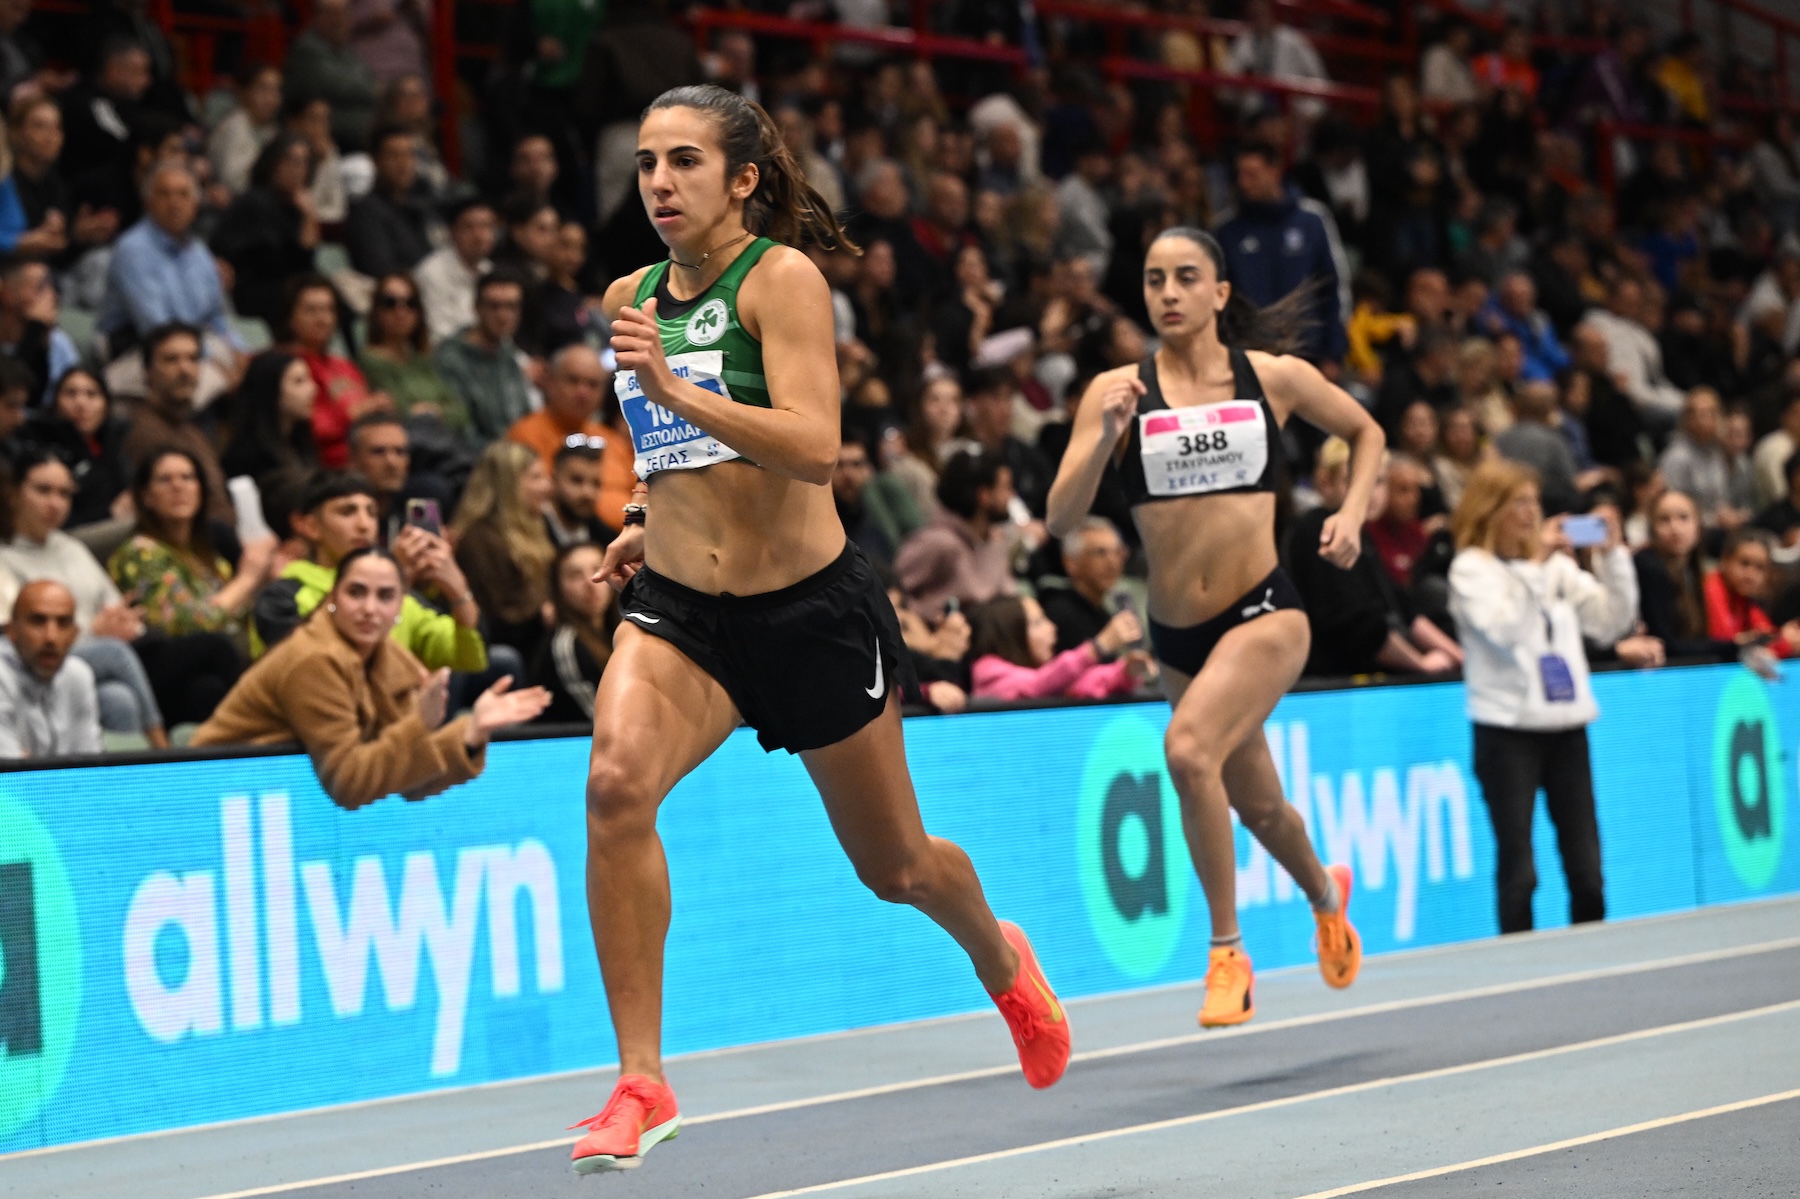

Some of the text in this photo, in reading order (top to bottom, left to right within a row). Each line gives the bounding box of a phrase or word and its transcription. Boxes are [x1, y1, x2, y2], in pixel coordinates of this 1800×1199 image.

[644, 401, 684, 427] 10
[1178, 431, 1228, 456] 388
[646, 450, 692, 473] ΣΕΓΑΣ
[1165, 451, 1244, 472] ΣΤΑΥΡΙΑΝΟΥ
[1167, 472, 1218, 490] ΣΕΓΑΣ
[124, 792, 564, 1076] allwyn
